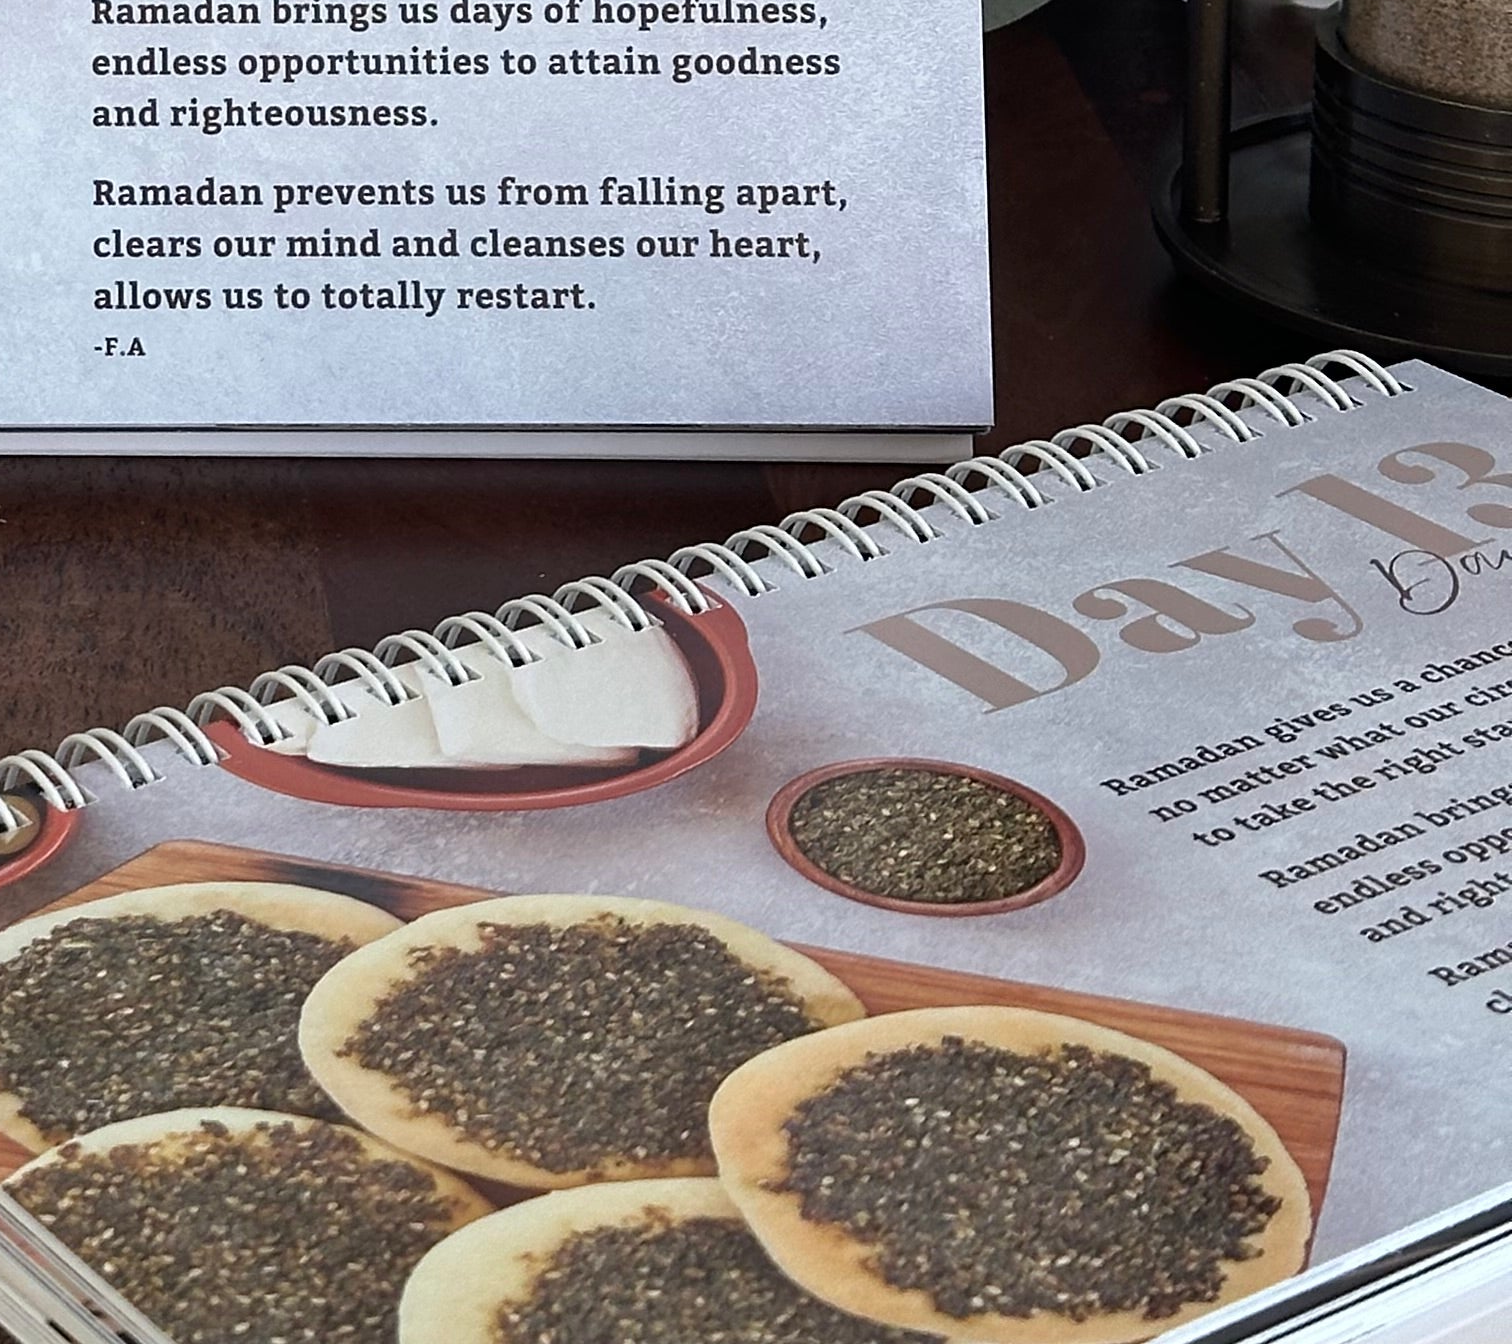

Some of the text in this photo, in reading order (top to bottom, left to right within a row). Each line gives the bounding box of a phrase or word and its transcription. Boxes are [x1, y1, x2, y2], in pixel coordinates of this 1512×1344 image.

[398, 3, 439, 24] us
[92, 45, 841, 84] endless opportunities to attain goodness
[92, 97, 438, 136] and righteousness.
[93, 176, 847, 215] Ramadan prevents us from falling apart,
[93, 227, 821, 265] clears our mind and cleanses our heart,
[93, 280, 596, 318] allows us to totally restart.
[94, 337, 146, 357] -F.A
[1369, 549, 1512, 615] Da
[843, 529, 1364, 714] Day
[1100, 641, 1512, 797] Ramadan gives us a chanc
[1148, 796, 1199, 823] no
[1202, 751, 1317, 805] matter
[1314, 723, 1406, 760] what
[1403, 701, 1464, 729] our
[1192, 719, 1512, 848] to take the right sta
[1258, 823, 1426, 890] Ramadan
[1313, 859, 1443, 914] endless
[1360, 906, 1433, 943] and
[1427, 941, 1512, 987] Ram
